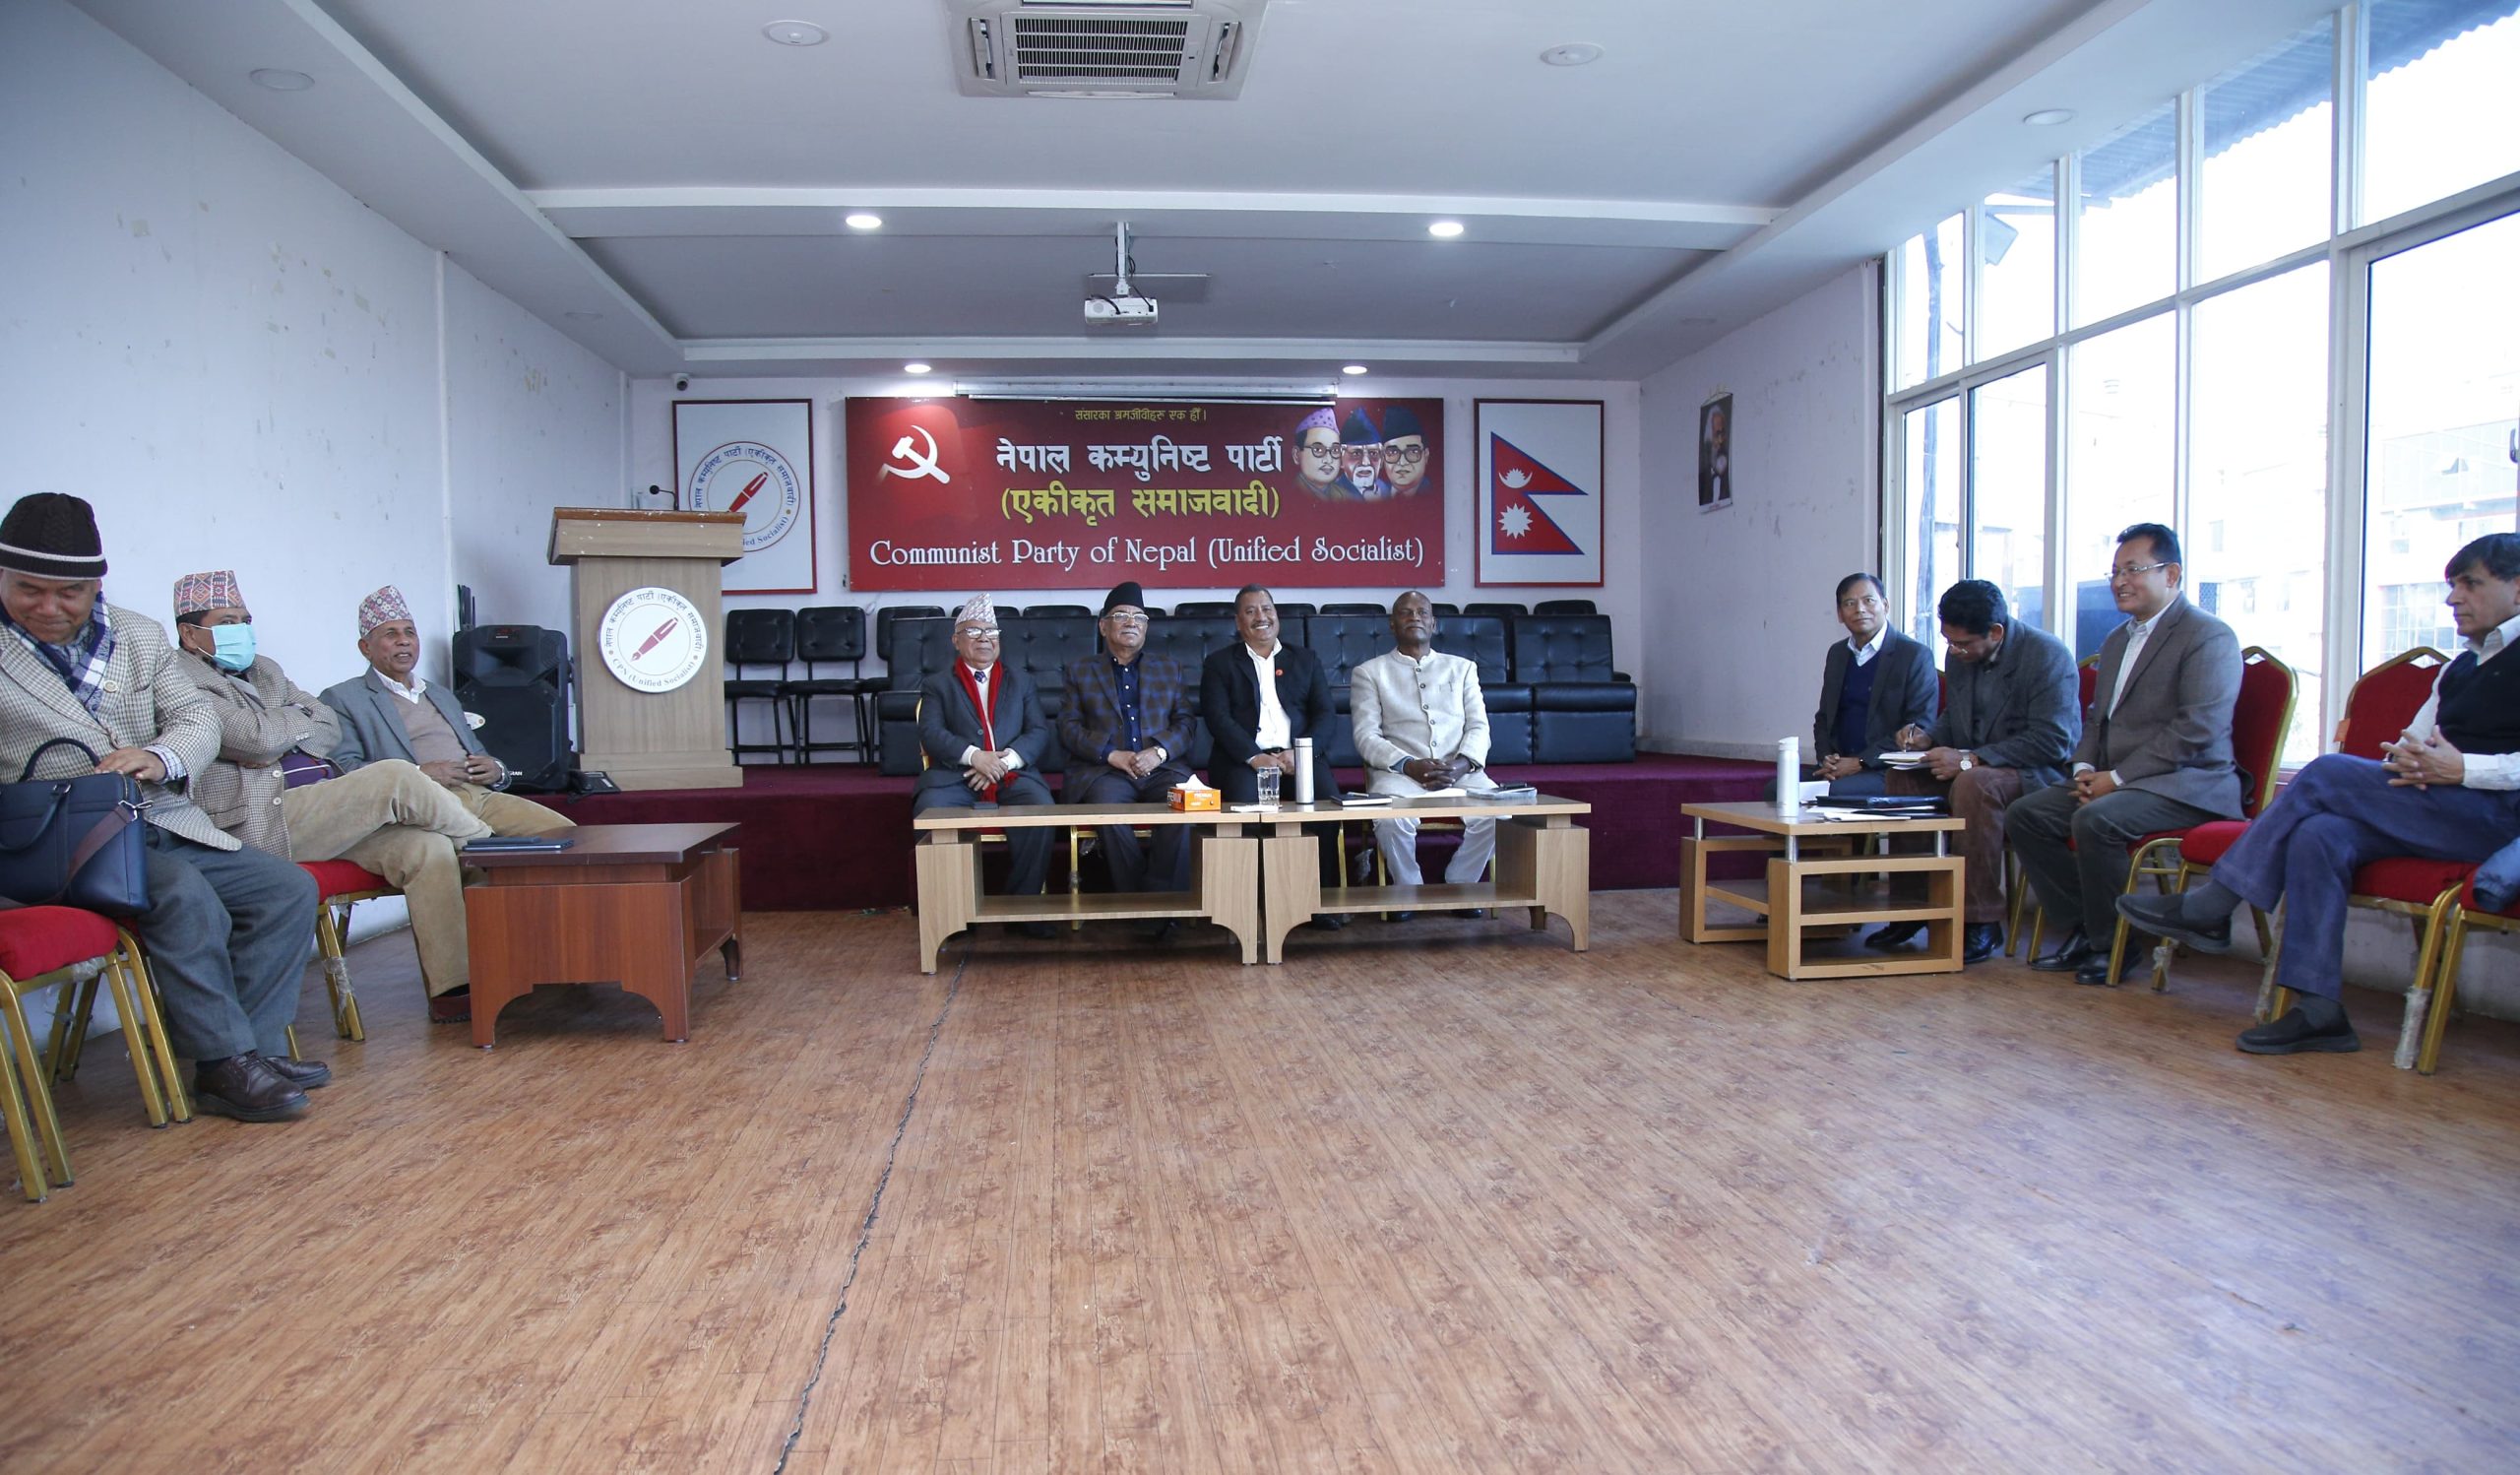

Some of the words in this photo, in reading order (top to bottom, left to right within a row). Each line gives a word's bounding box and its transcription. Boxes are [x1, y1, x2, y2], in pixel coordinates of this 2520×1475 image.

[996, 437, 1070, 474] नेपाल
[1087, 434, 1211, 481] कम्युनिष्ट
[1226, 435, 1283, 473] पार्टी
[1001, 480, 1115, 526] (एकीकृत
[1131, 480, 1280, 519] समाजवादी)
[757, 516, 788, 544] Socialist)
[870, 541, 1002, 565] Communist
[1012, 539, 1081, 572] Party
[1090, 537, 1118, 564] of
[1125, 539, 1197, 571] Nepal
[1208, 536, 1302, 569] (Unified
[1311, 536, 1424, 568] Socialist)
[629, 674, 662, 687] (Unified
[663, 662, 696, 685] Socialist)
